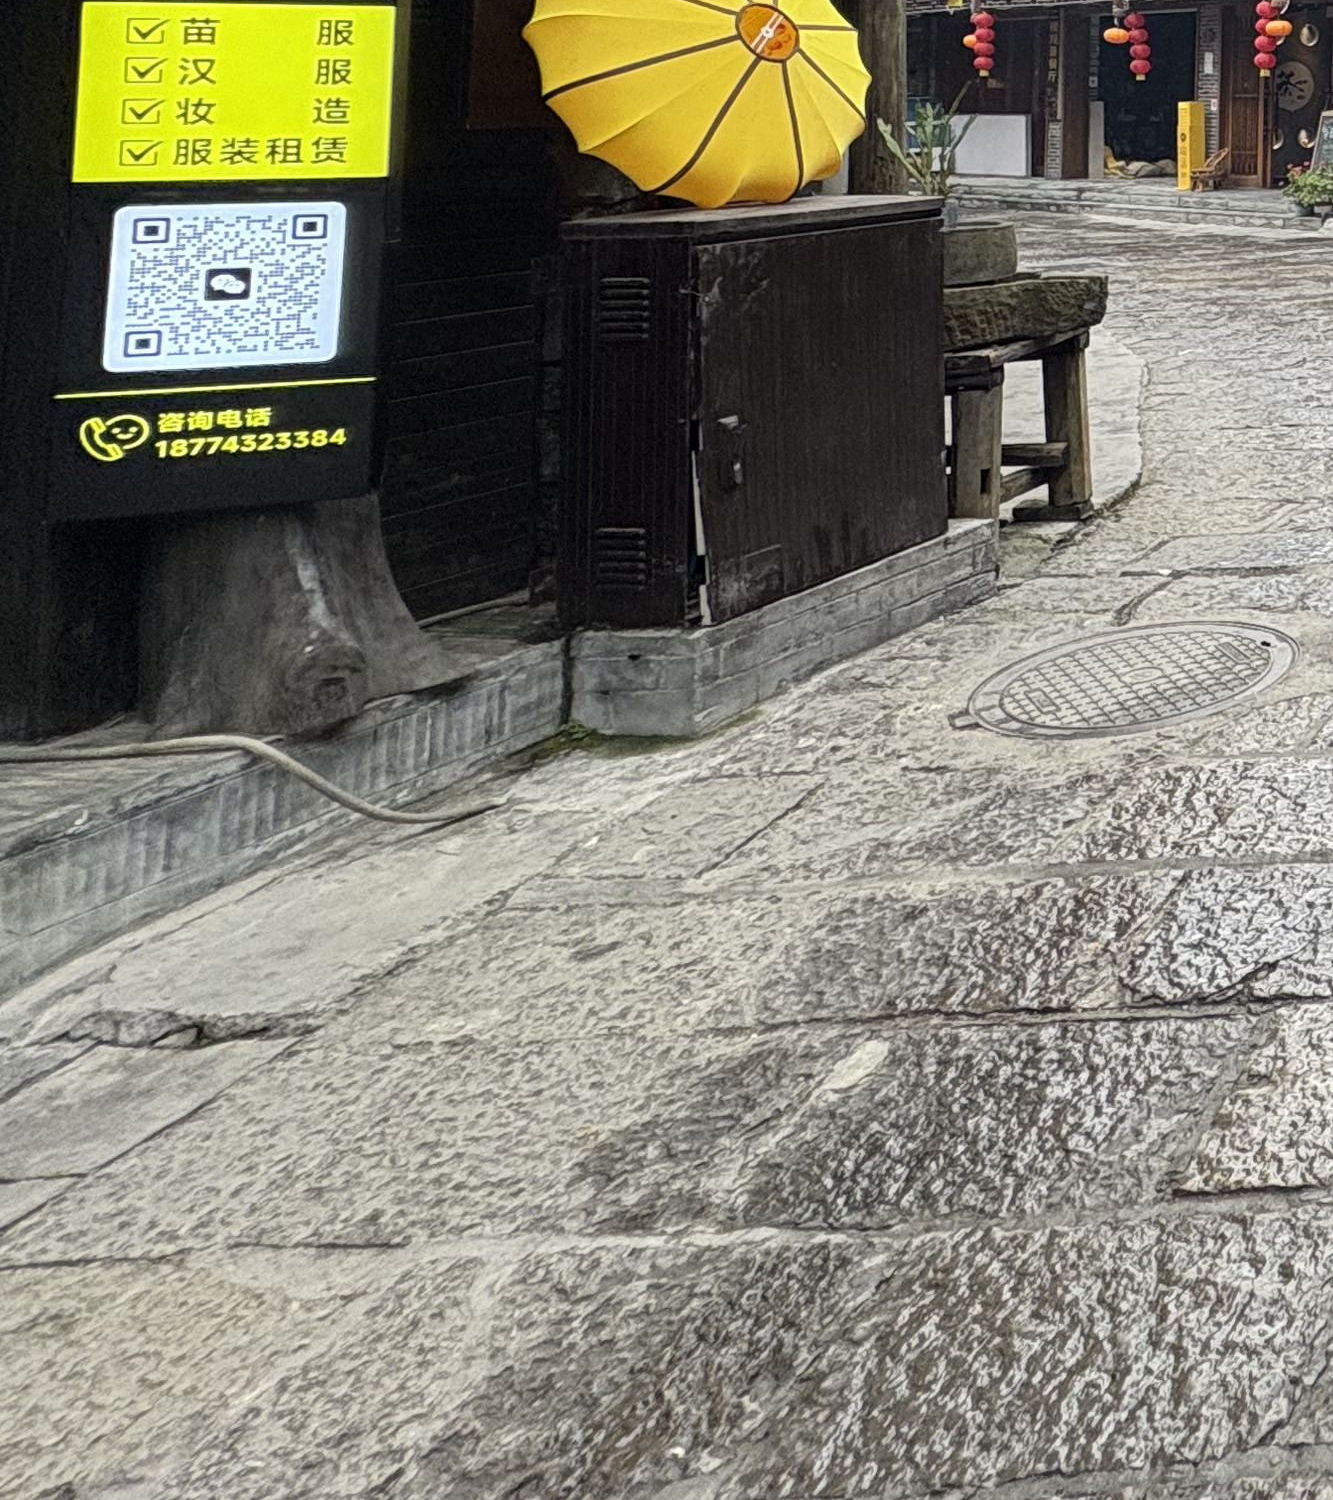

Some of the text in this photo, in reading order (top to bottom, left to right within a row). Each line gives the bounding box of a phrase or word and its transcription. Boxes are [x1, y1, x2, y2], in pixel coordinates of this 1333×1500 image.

[172, 136, 349, 166] 服装租赁
[157, 407, 272, 434] 咨询电话
[154, 428, 348, 459] 18774323384
